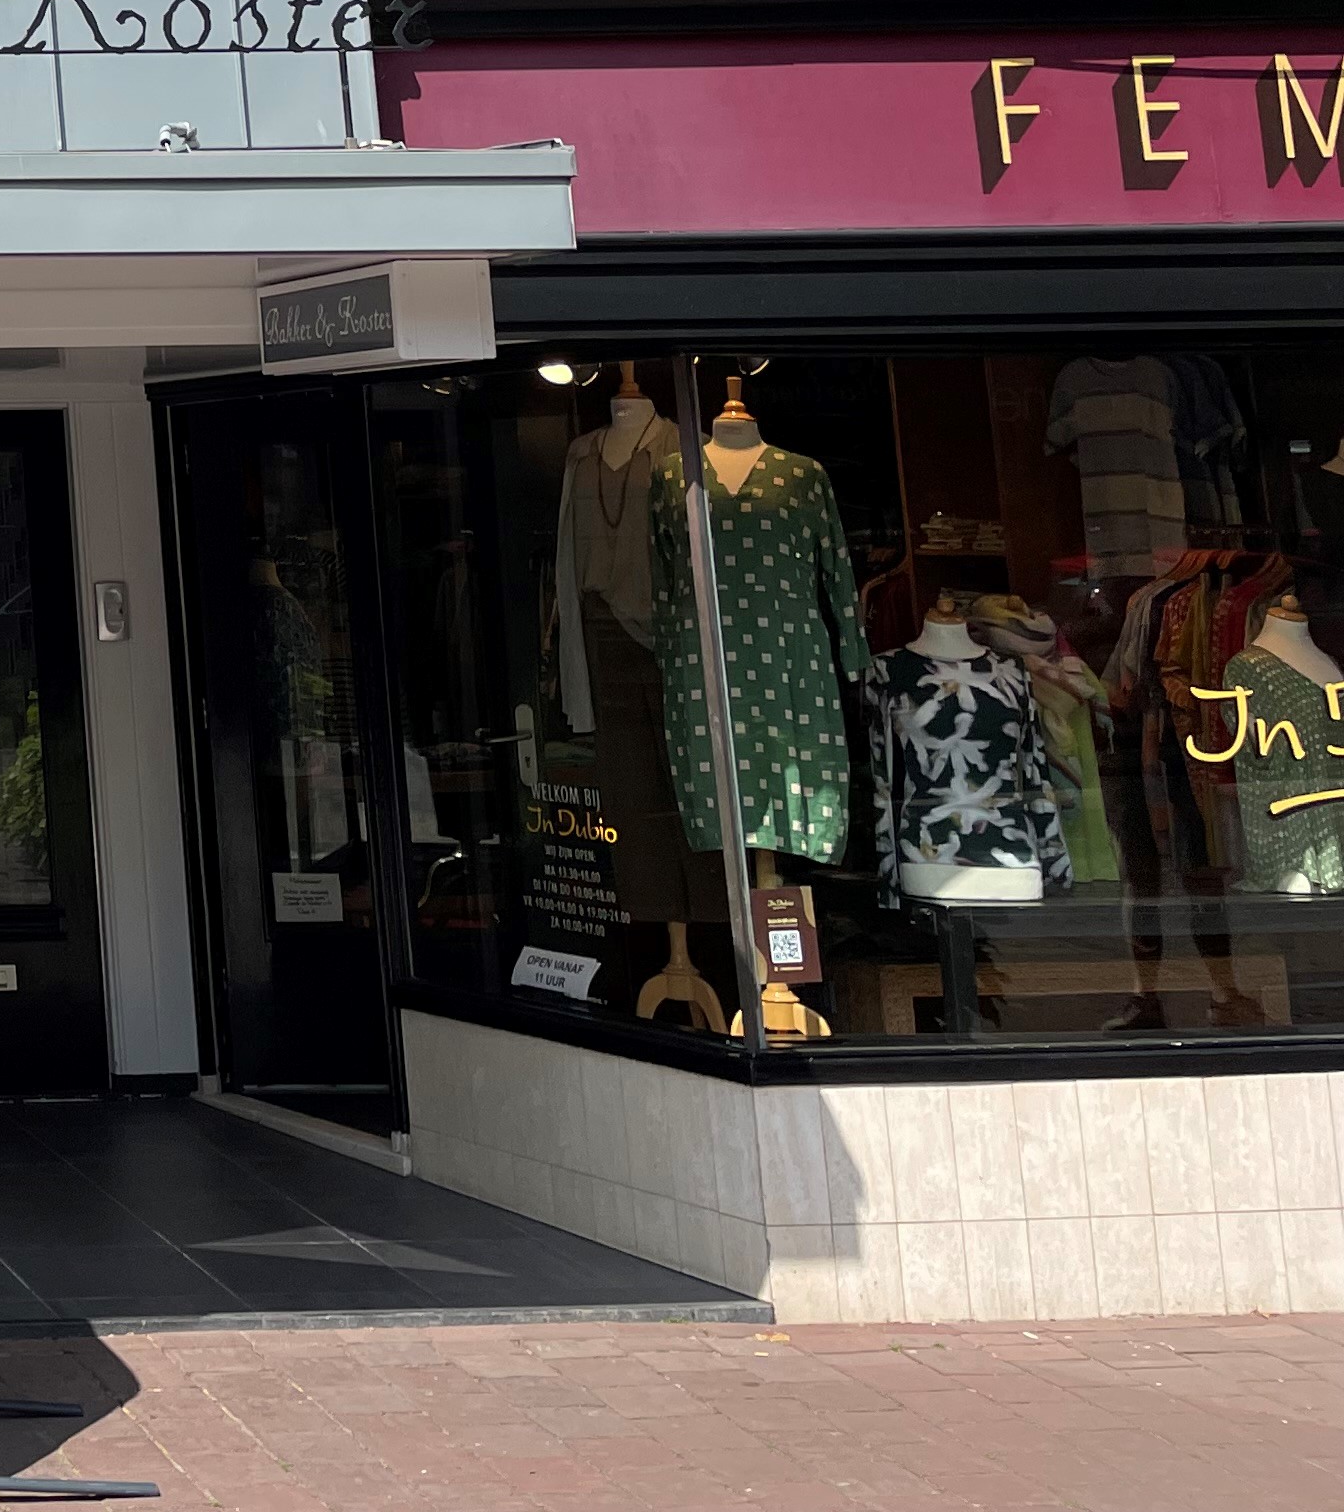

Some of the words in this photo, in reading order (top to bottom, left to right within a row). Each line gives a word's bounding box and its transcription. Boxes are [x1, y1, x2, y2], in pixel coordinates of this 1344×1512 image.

[264, 304, 311, 345] Bakker
[338, 295, 392, 336] Koster
[531, 782, 579, 805] WELKOM
[584, 788, 601, 812] BIJ
[558, 808, 618, 843] Dubio
[526, 955, 553, 968] OPEN
[554, 960, 585, 975] VANAF
[535, 972, 544, 984] 11
[545, 973, 566, 988] UUR
